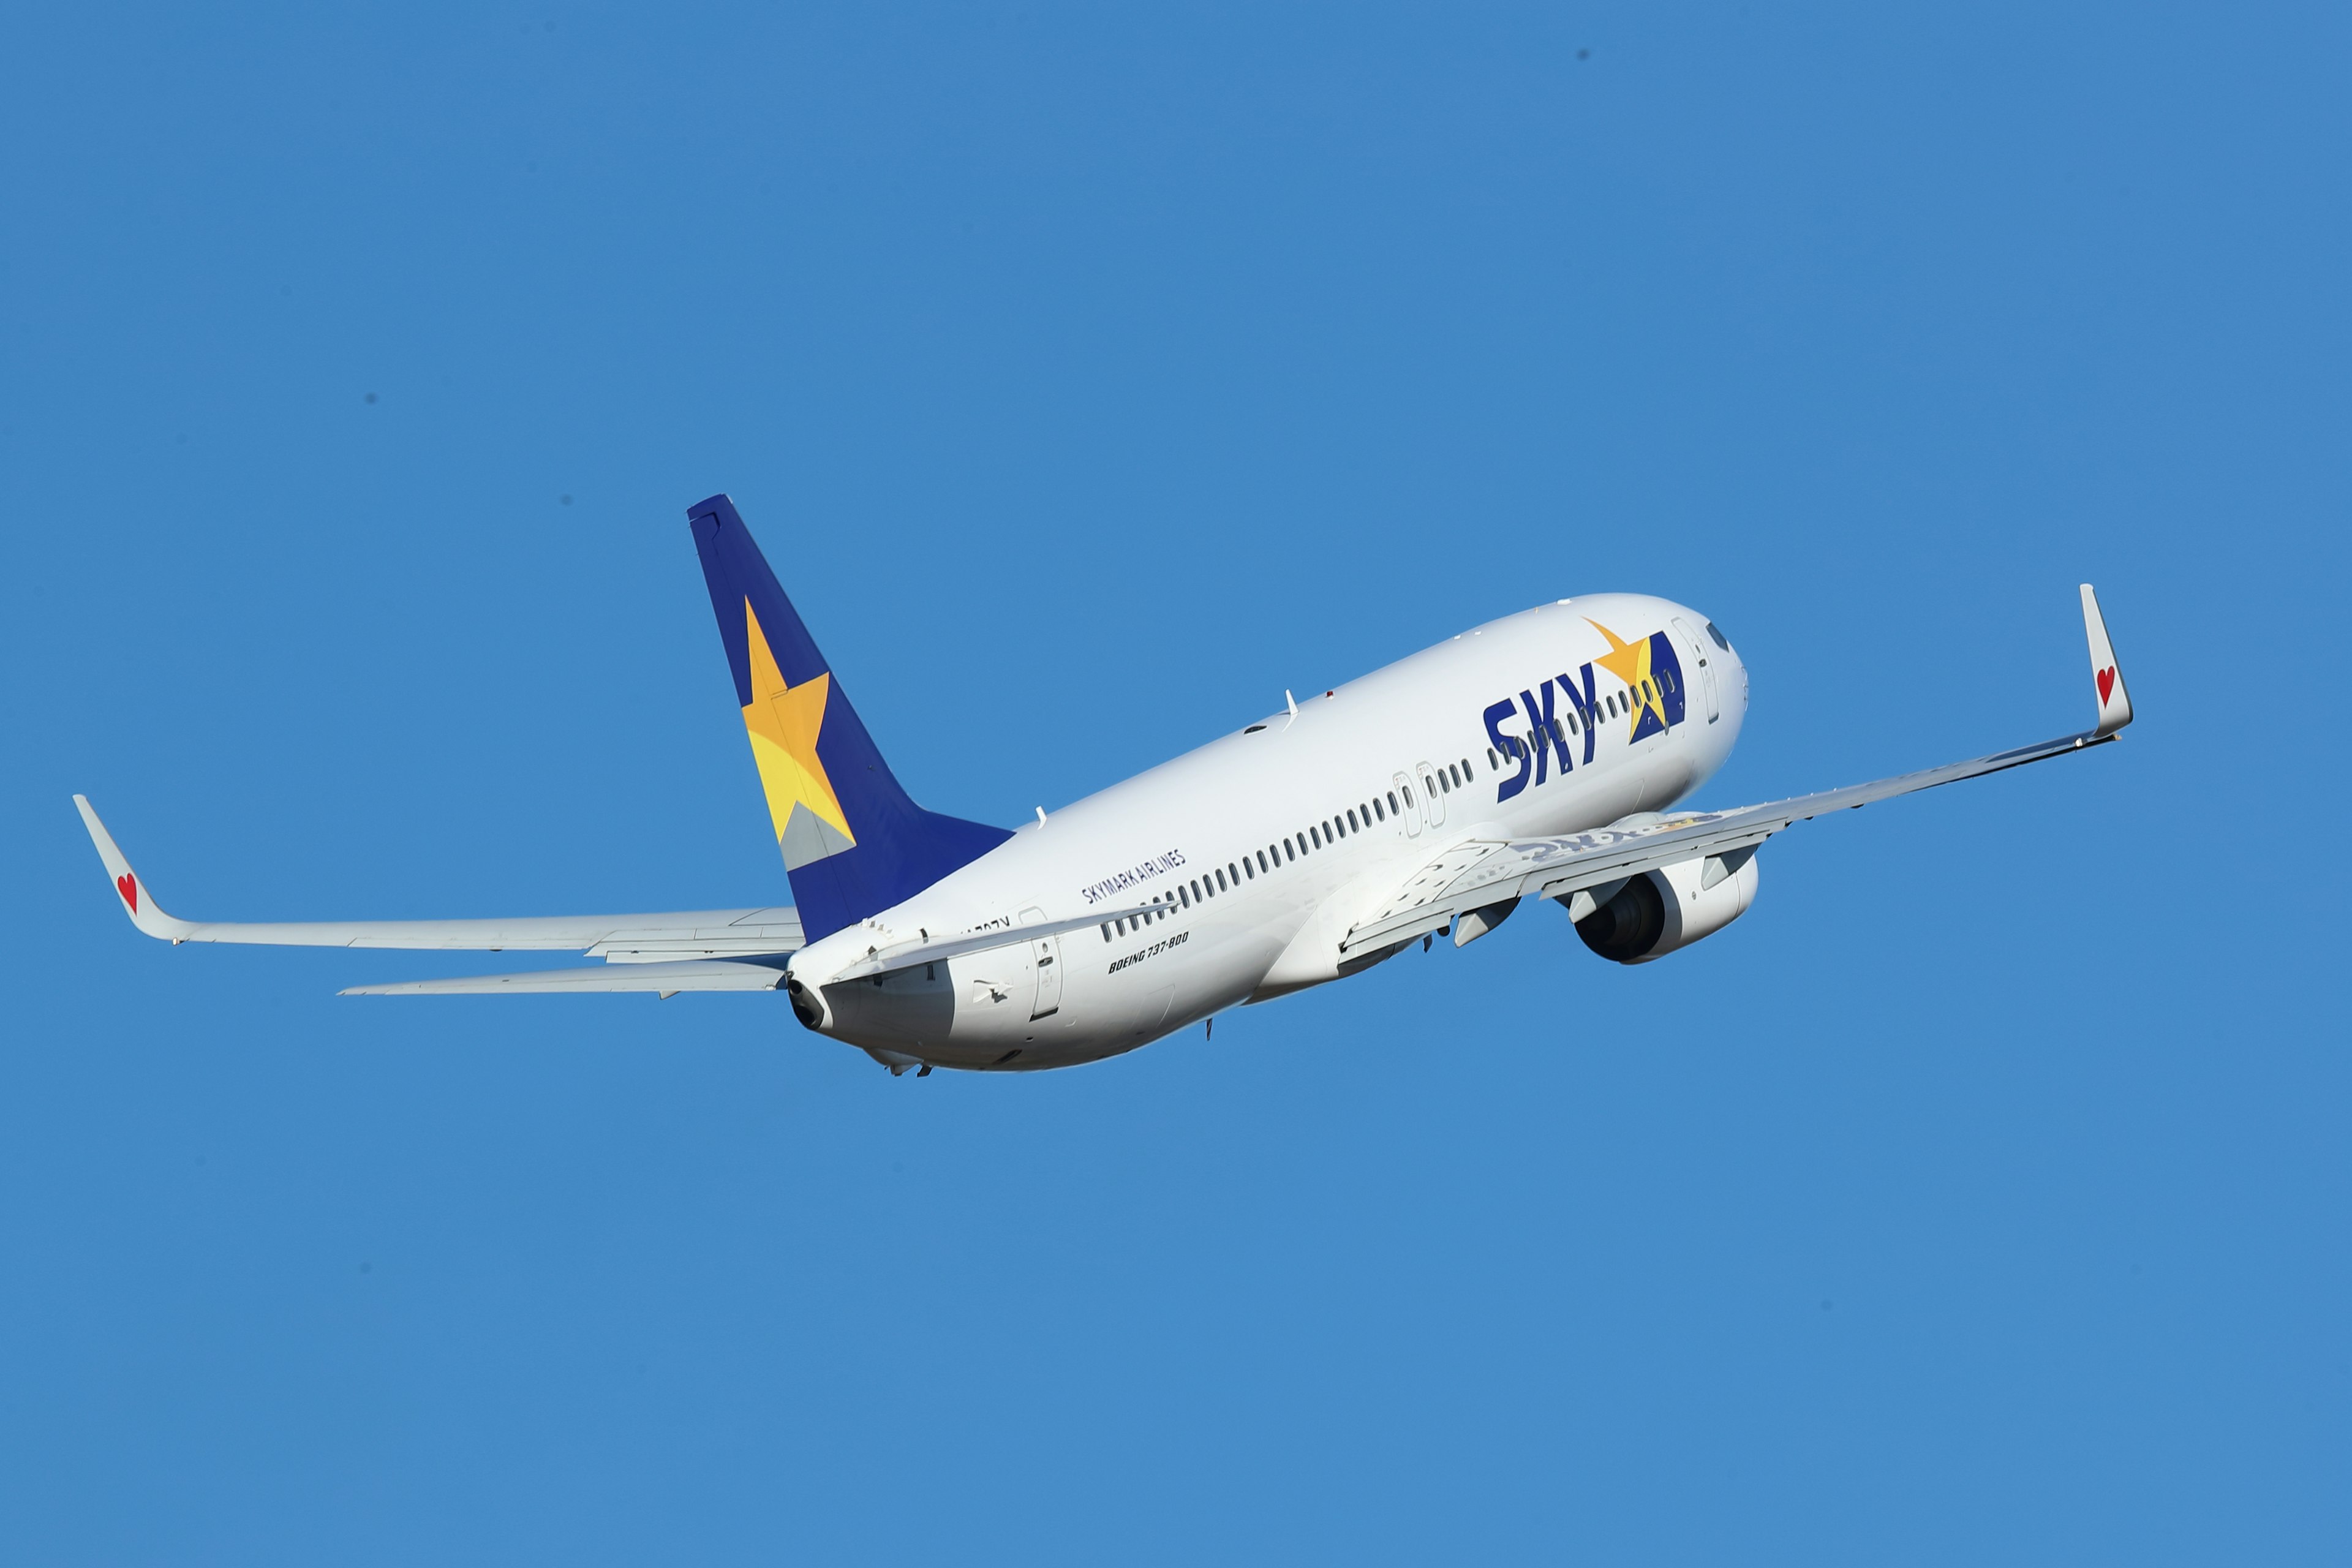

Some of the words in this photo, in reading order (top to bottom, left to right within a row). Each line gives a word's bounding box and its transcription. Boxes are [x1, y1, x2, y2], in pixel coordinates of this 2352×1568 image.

[1483, 662, 1597, 804] SKY
[1082, 870, 1139, 904] SKYMARK
[1135, 849, 1186, 882] AIRLINES
[1108, 949, 1145, 974] BOEING
[1147, 931, 1189, 959] 737-800
